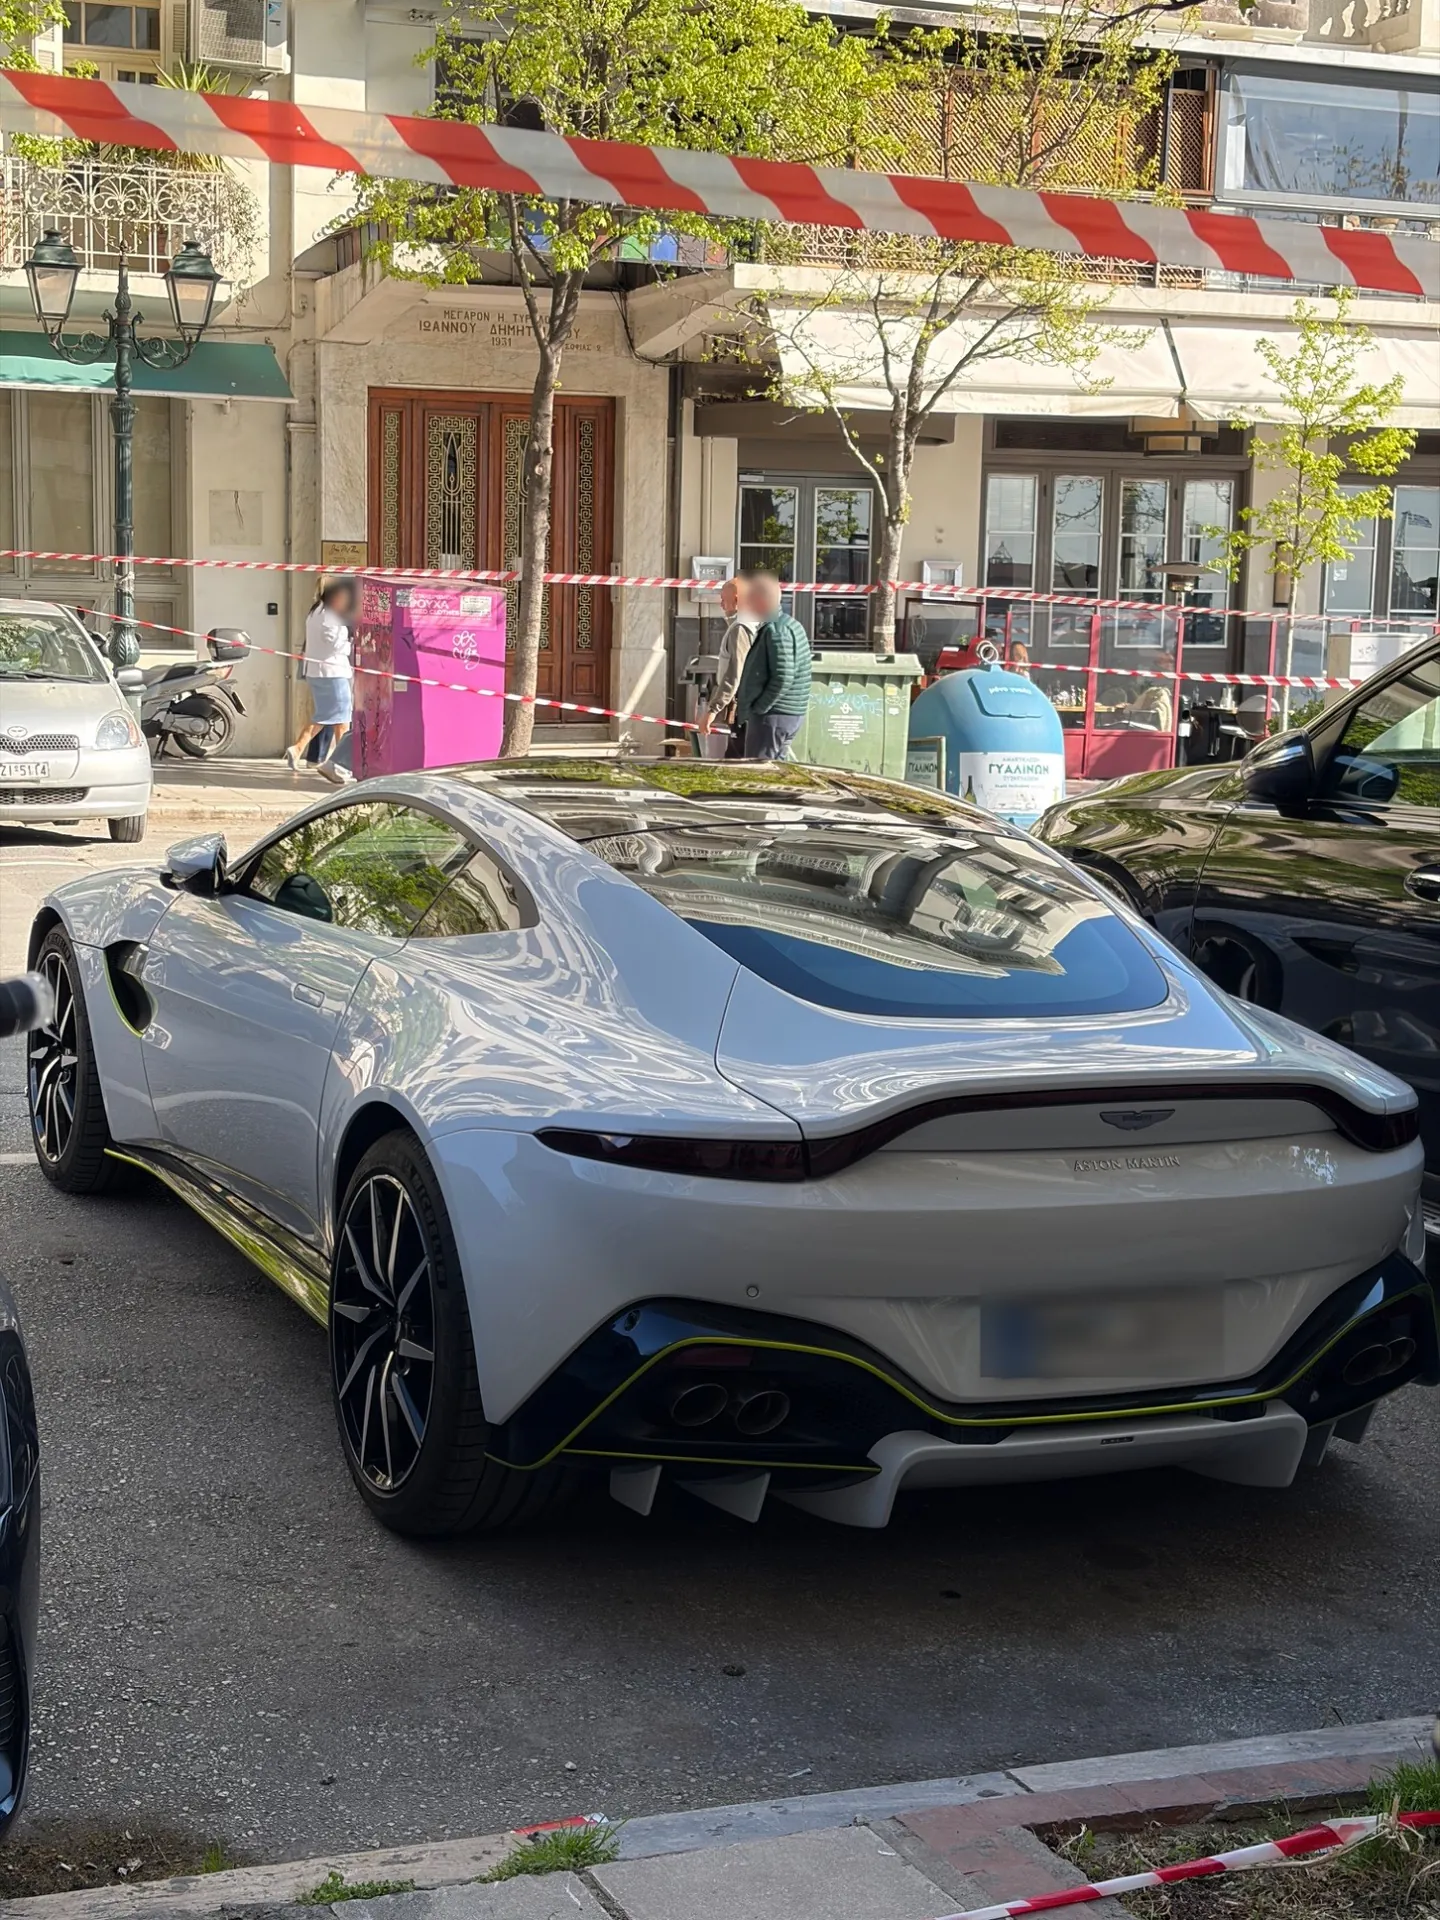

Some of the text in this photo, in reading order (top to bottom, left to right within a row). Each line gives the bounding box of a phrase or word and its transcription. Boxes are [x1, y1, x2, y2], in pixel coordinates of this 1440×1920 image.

[443, 310, 490, 322] ΜΕΓΑΡΟΝ
[419, 320, 477, 334] ΙΩΑΝΝΟΥ
[491, 336, 512, 347] 1931
[988, 763, 1049, 775] ΓΥΑΛΙΝΩΝ
[1074, 1156, 1180, 1172] ASTON MARTIN
